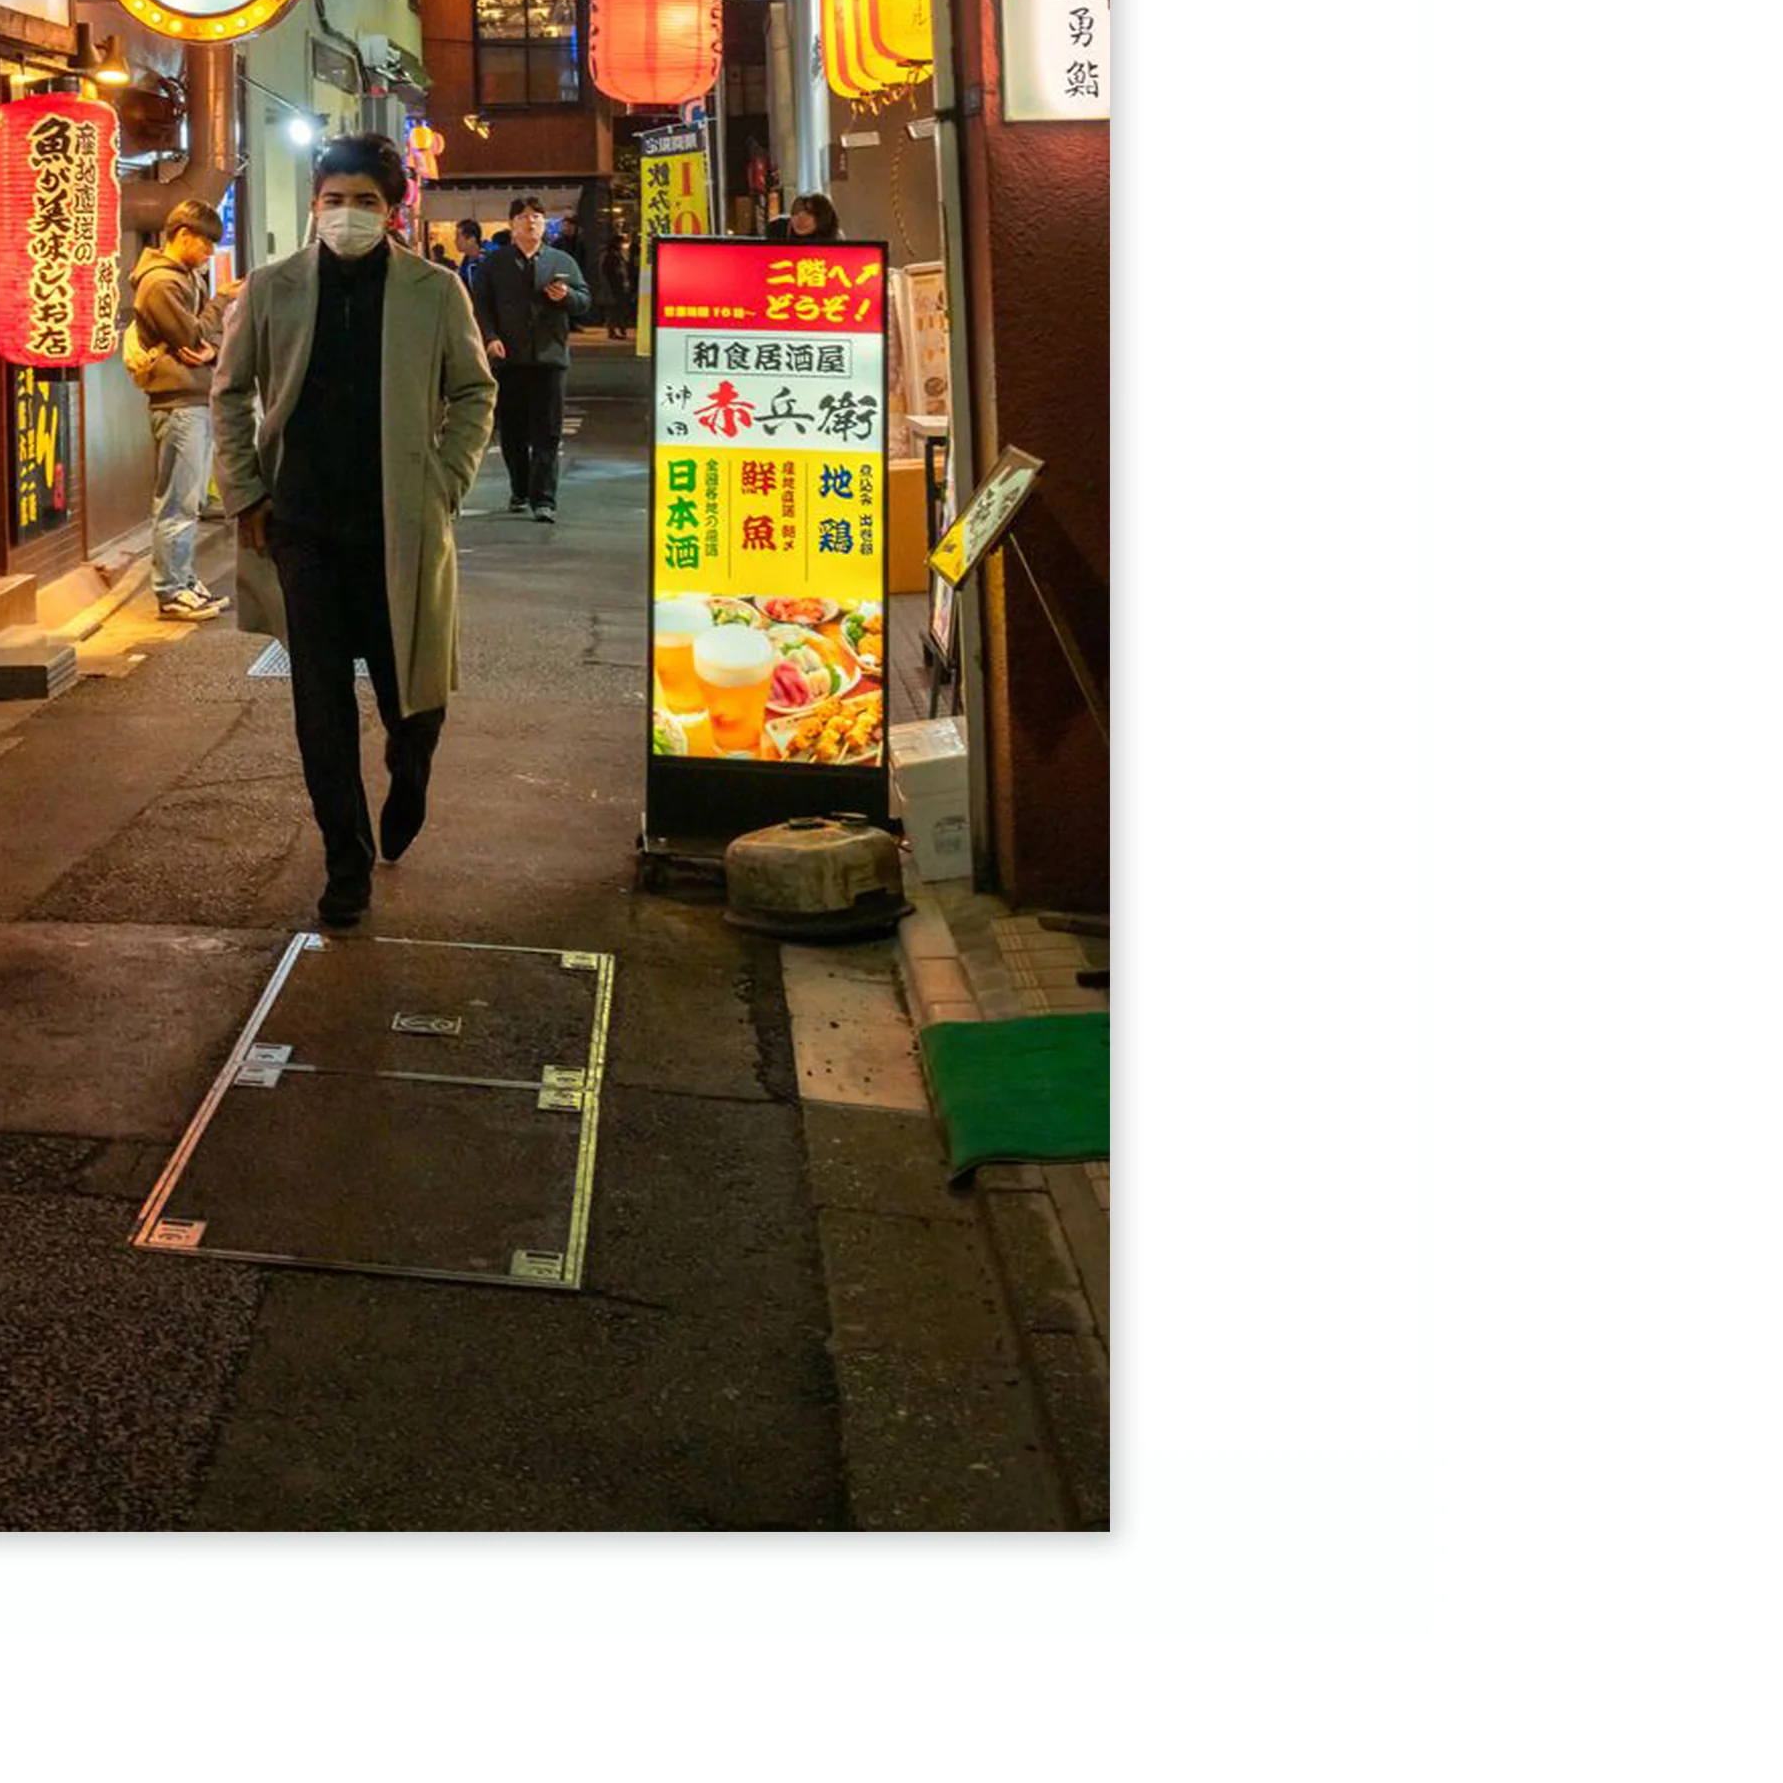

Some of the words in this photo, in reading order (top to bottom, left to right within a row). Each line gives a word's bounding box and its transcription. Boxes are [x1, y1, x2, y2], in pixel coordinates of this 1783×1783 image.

[30, 117, 74, 355] 魚が美味しいお店
[767, 259, 853, 288] 二階へ
[693, 341, 846, 373] 和食居酒屋
[694, 380, 878, 442] 赤兵衛
[666, 459, 699, 570] 日本酒
[742, 460, 777, 550] 鮮魚
[819, 464, 853, 554] 地鶏
